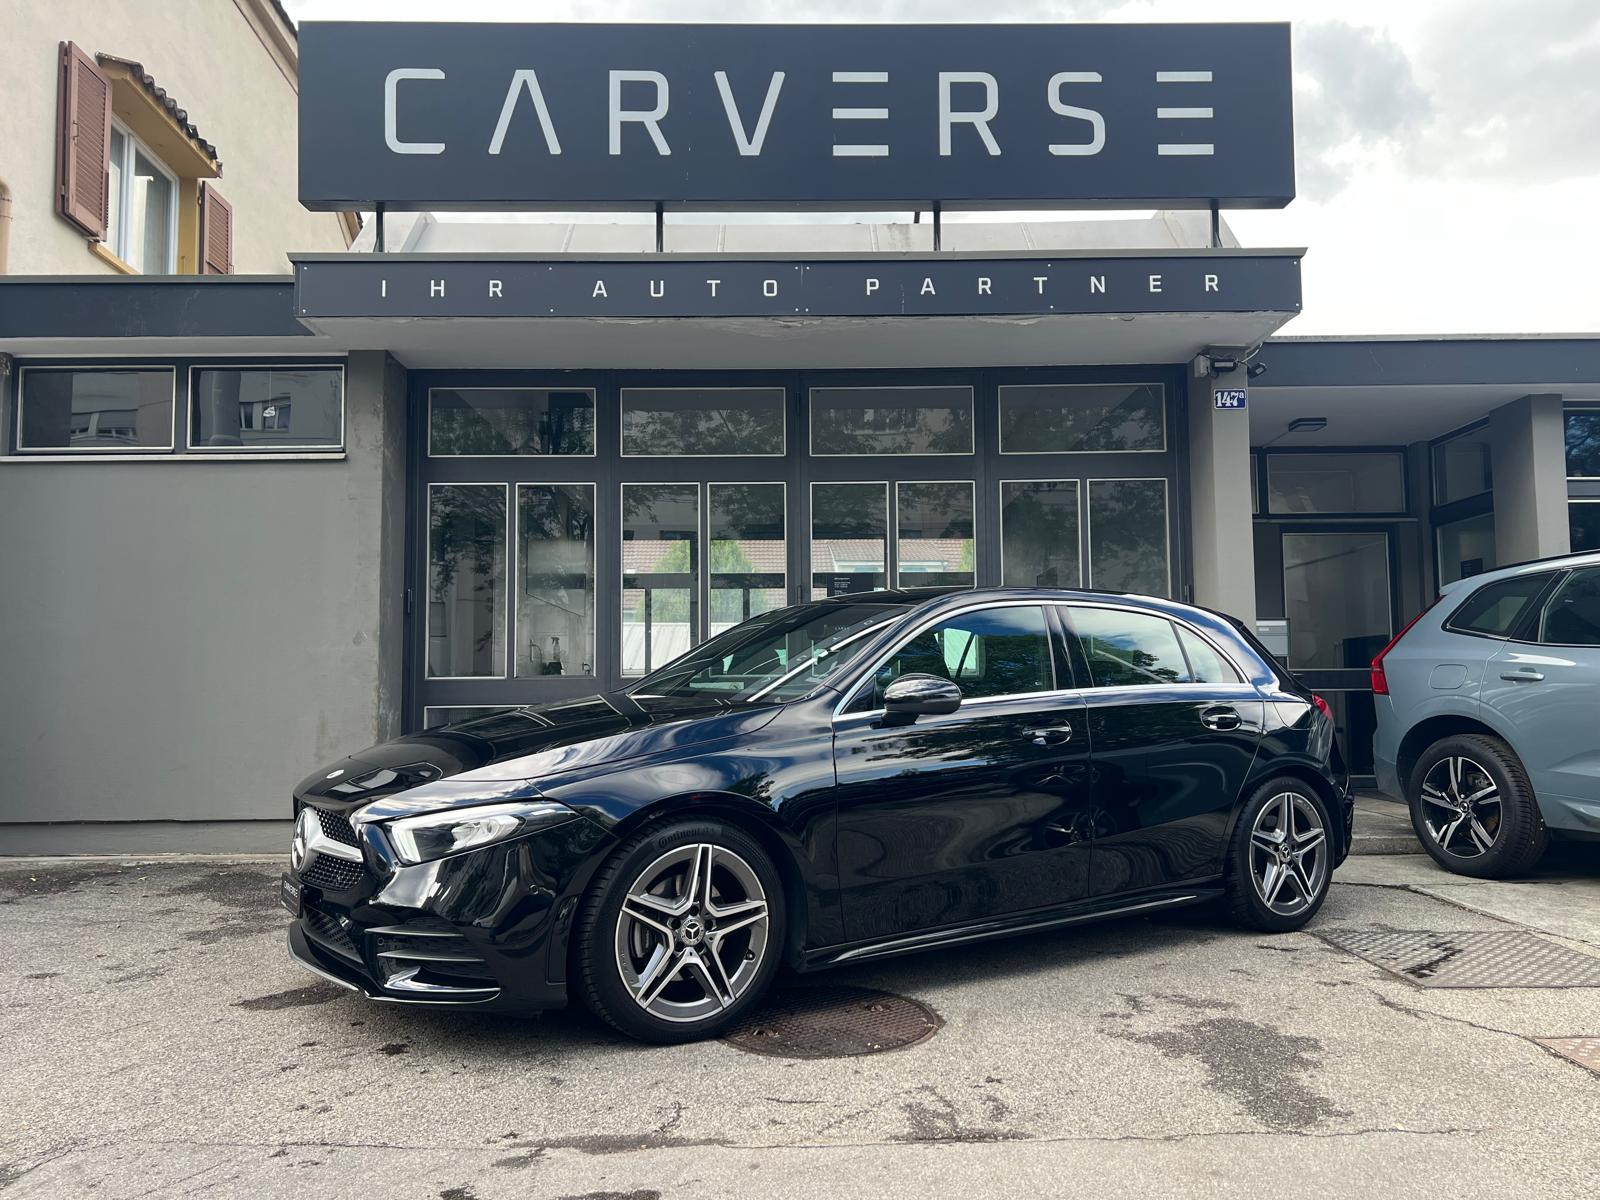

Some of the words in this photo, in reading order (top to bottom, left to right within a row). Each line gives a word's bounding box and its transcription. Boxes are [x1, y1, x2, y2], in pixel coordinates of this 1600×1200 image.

[385, 68, 1214, 156] CARVERSE
[381, 279, 503, 298] IHR
[593, 279, 778, 298] AUTO
[866, 274, 1219, 296] PARTNER
[658, 827, 715, 847] Continen
